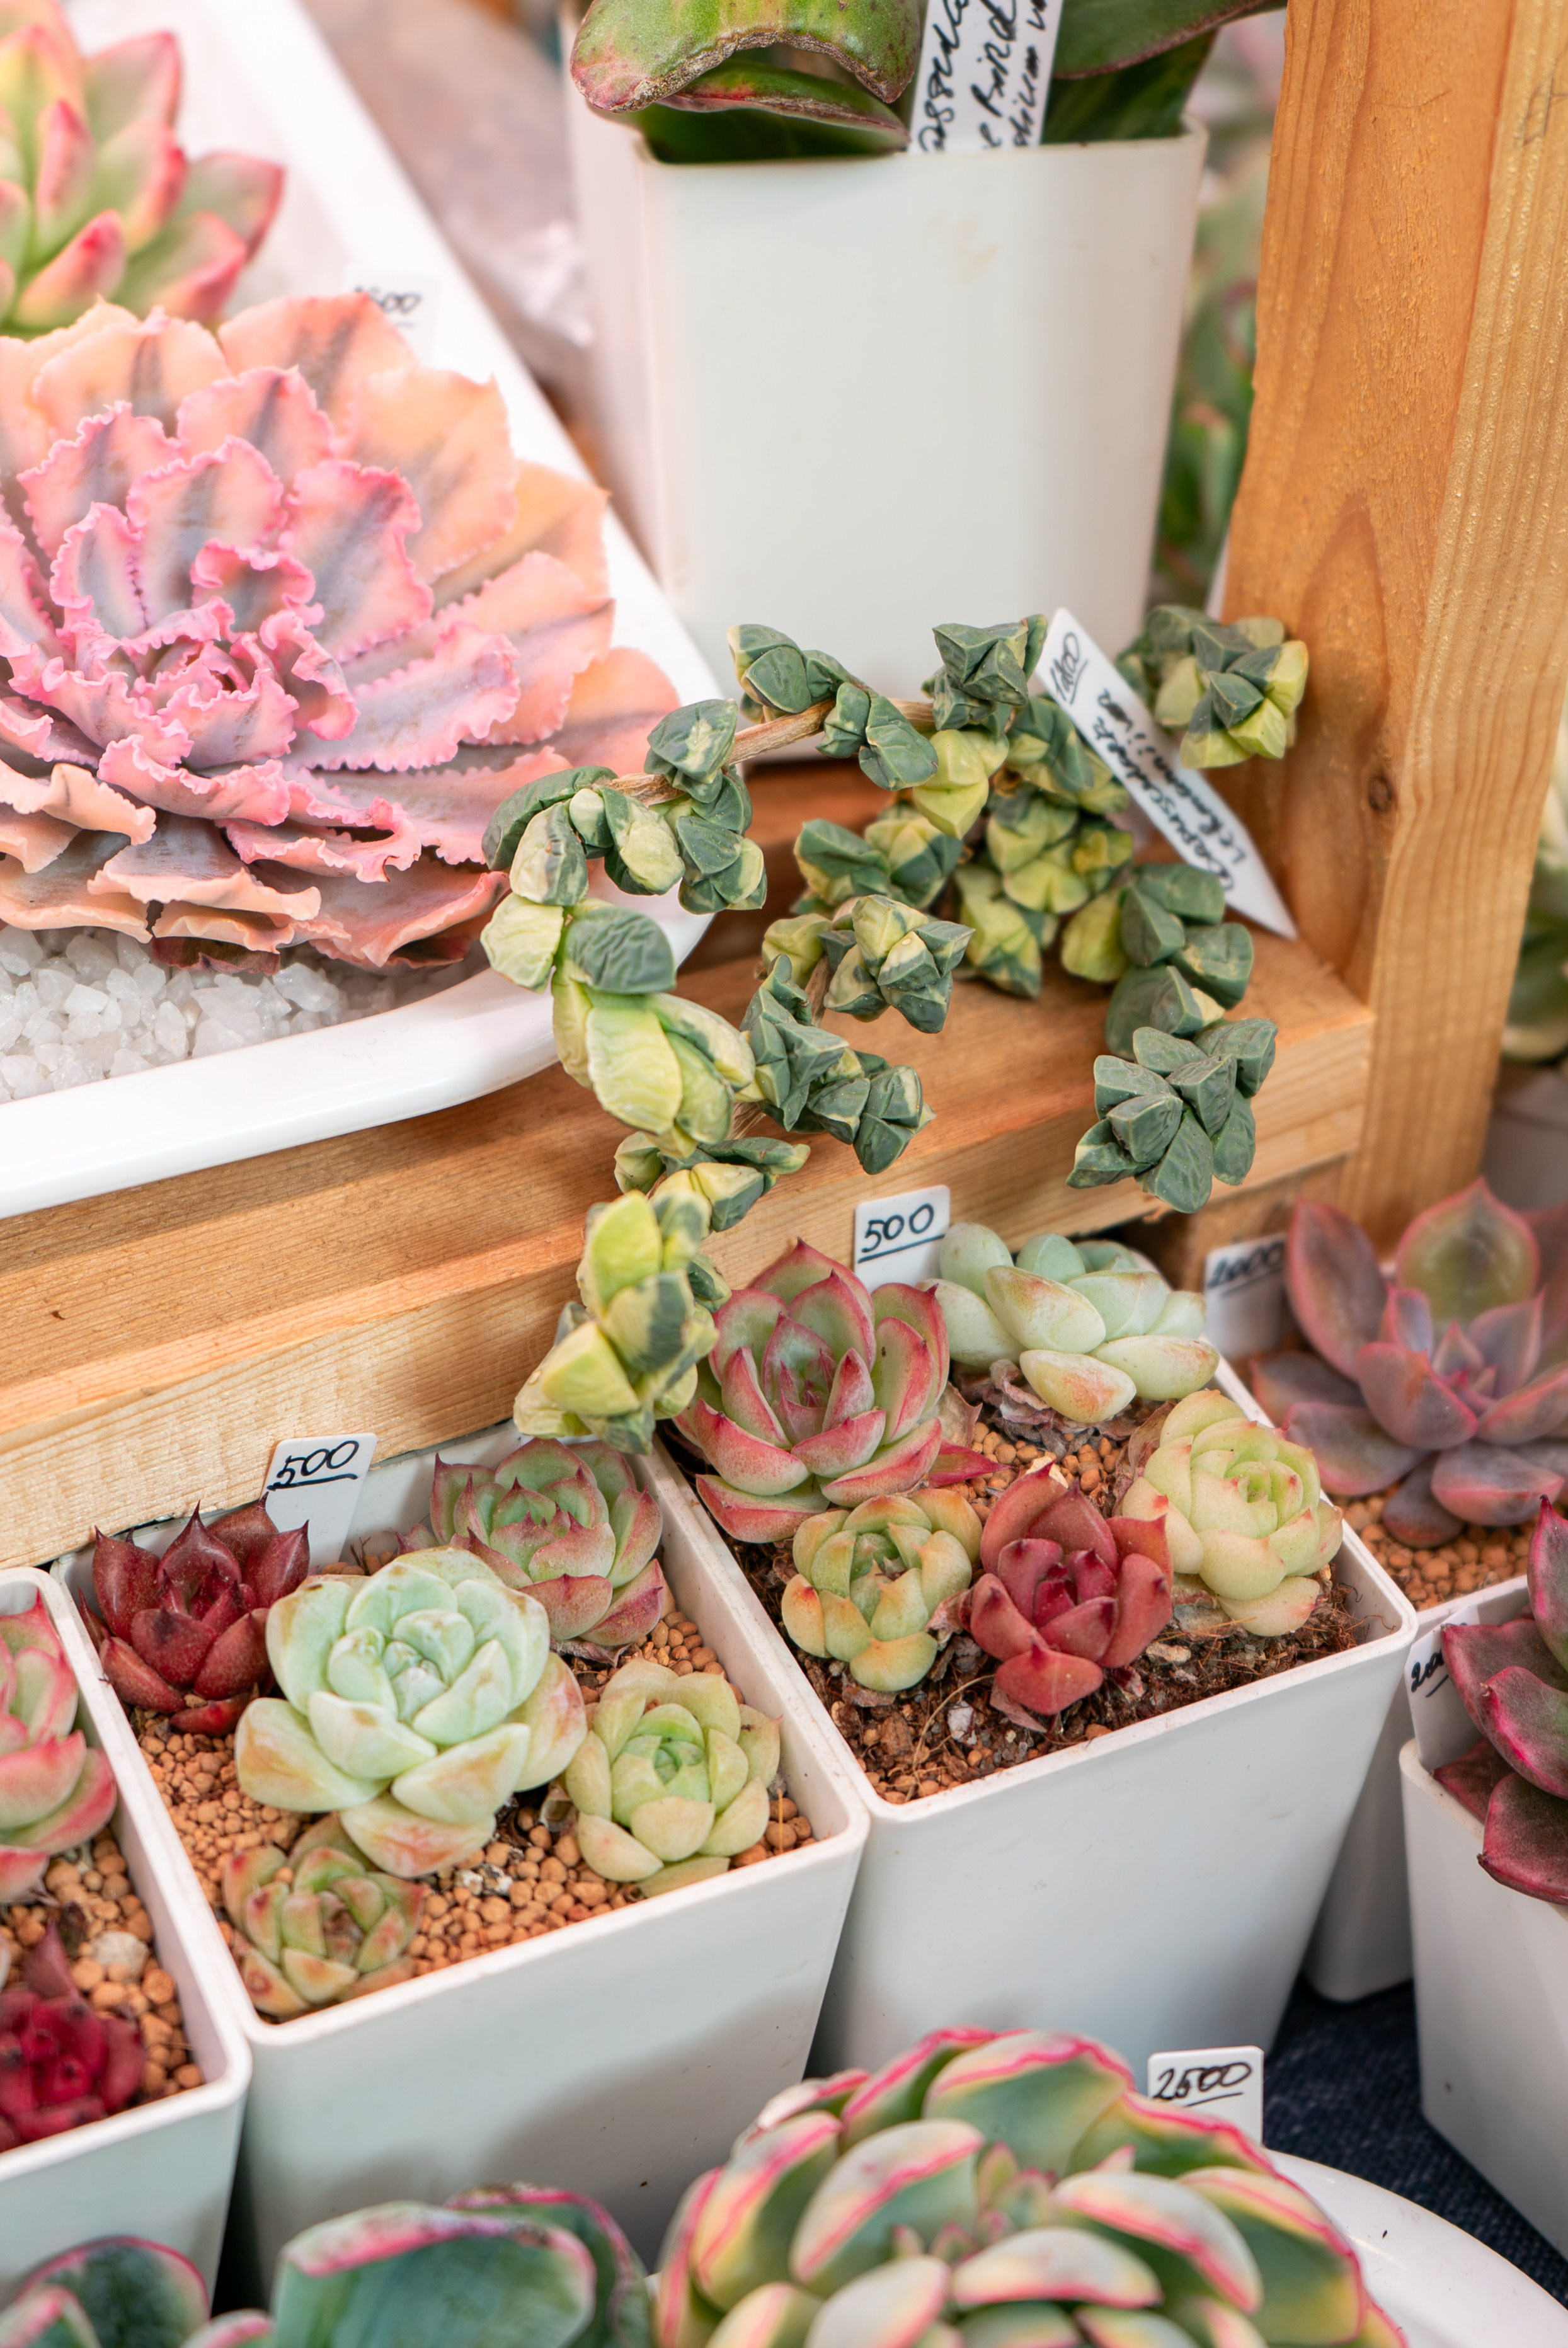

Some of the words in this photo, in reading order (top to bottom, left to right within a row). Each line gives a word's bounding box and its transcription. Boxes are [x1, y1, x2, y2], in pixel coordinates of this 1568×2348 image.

[861, 1203, 934, 1253] 500
[273, 1440, 360, 1486] 500
[1152, 2061, 1253, 2100] 2500
